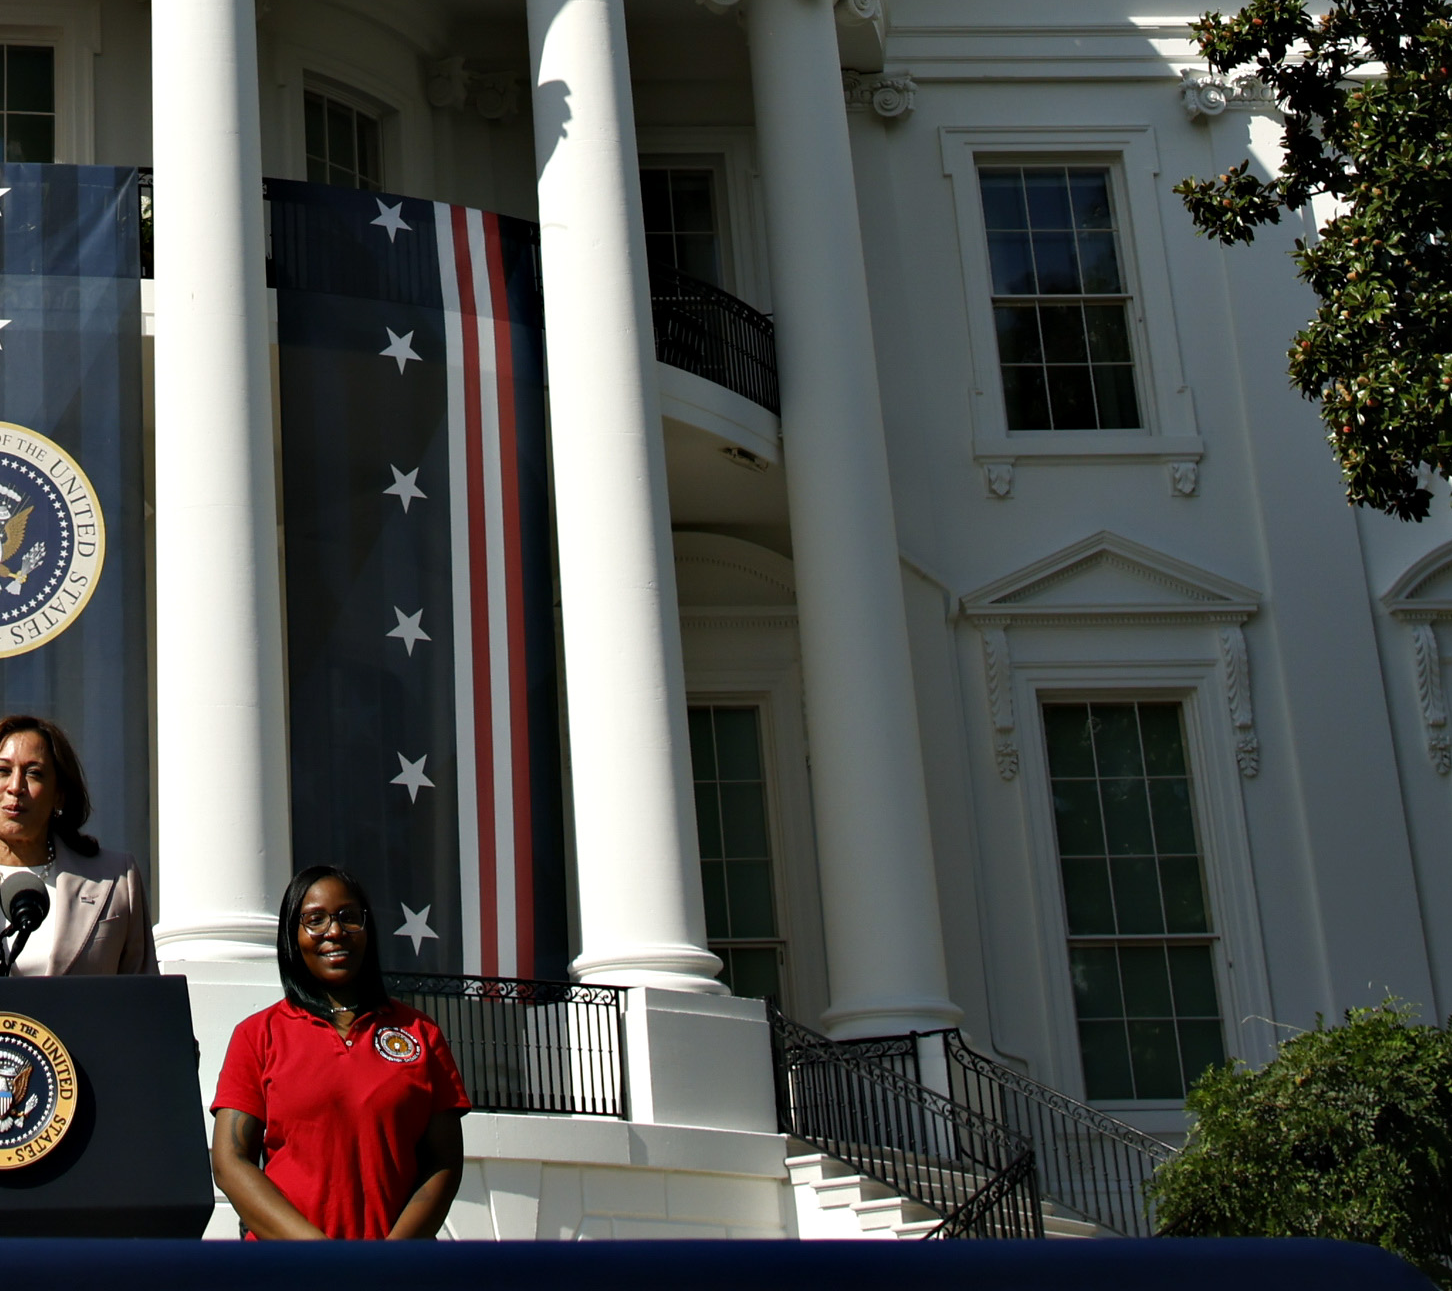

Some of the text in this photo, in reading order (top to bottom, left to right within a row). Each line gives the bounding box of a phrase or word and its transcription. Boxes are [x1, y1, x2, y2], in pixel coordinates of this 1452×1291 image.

[16, 437, 48, 462] THE
[49, 457, 96, 558] UNITED
[10, 571, 88, 645] STATES
[3, 1019, 18, 1029] OF
[20, 1022, 39, 1038] THE
[41, 1036, 73, 1100] UNITED
[15, 1114, 67, 1162] STATES
